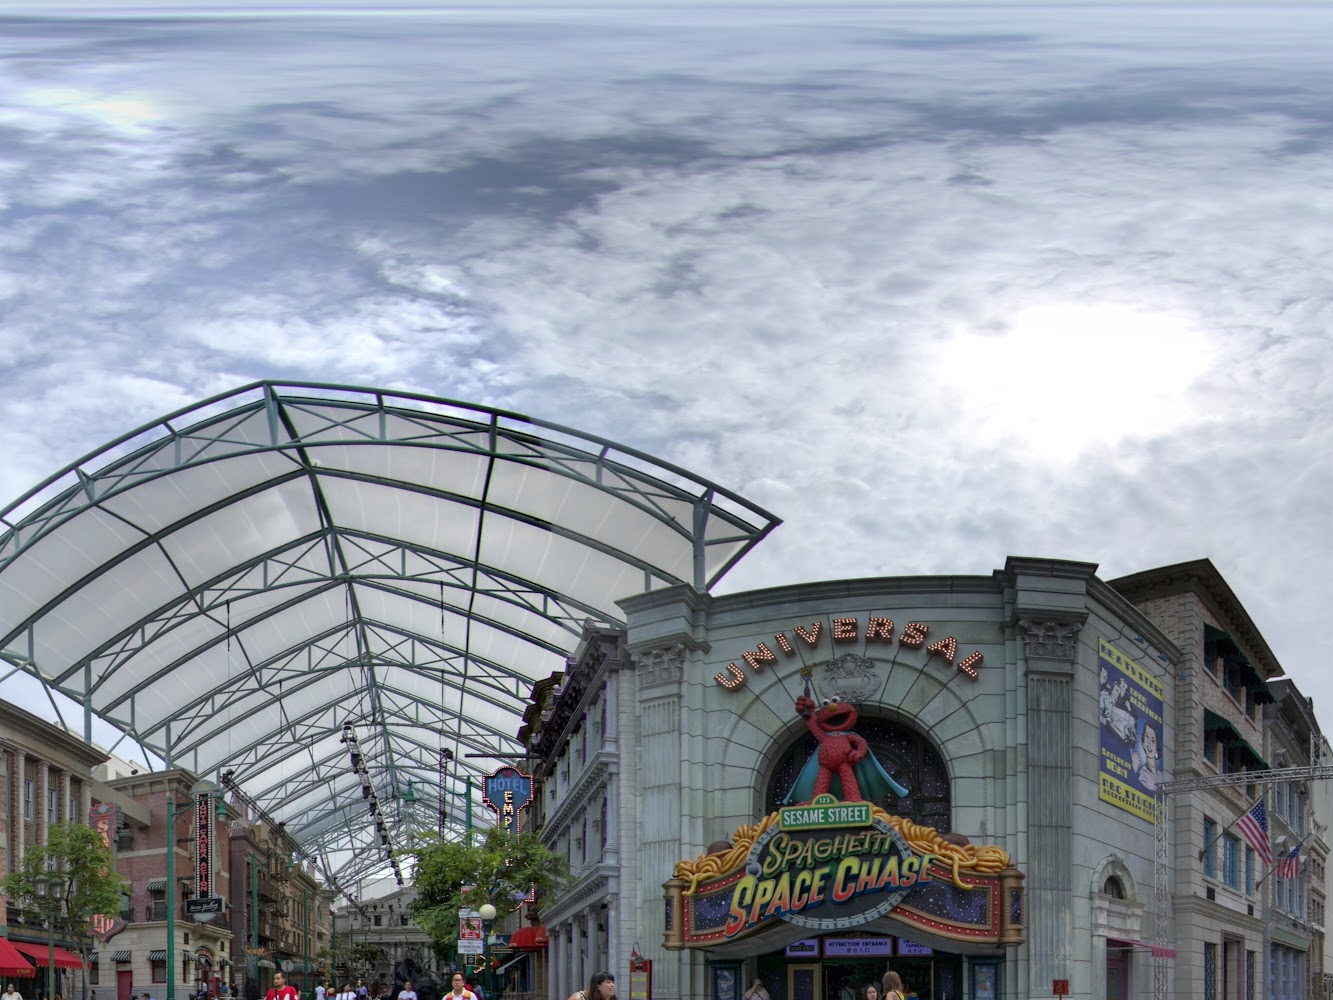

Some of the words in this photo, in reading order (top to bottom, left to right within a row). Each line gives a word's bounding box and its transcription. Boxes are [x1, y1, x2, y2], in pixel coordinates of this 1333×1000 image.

[714, 617, 984, 691] UNIVERSAL
[488, 778, 527, 795] HOTEL
[783, 808, 826, 826] SESAME
[828, 806, 868, 824] STREET
[199, 830, 208, 858] CAMERA
[762, 829, 894, 877] SPAGHETTI
[200, 862, 208, 892] ACTION
[724, 864, 828, 939] SPACE
[831, 854, 938, 902] CHASE
